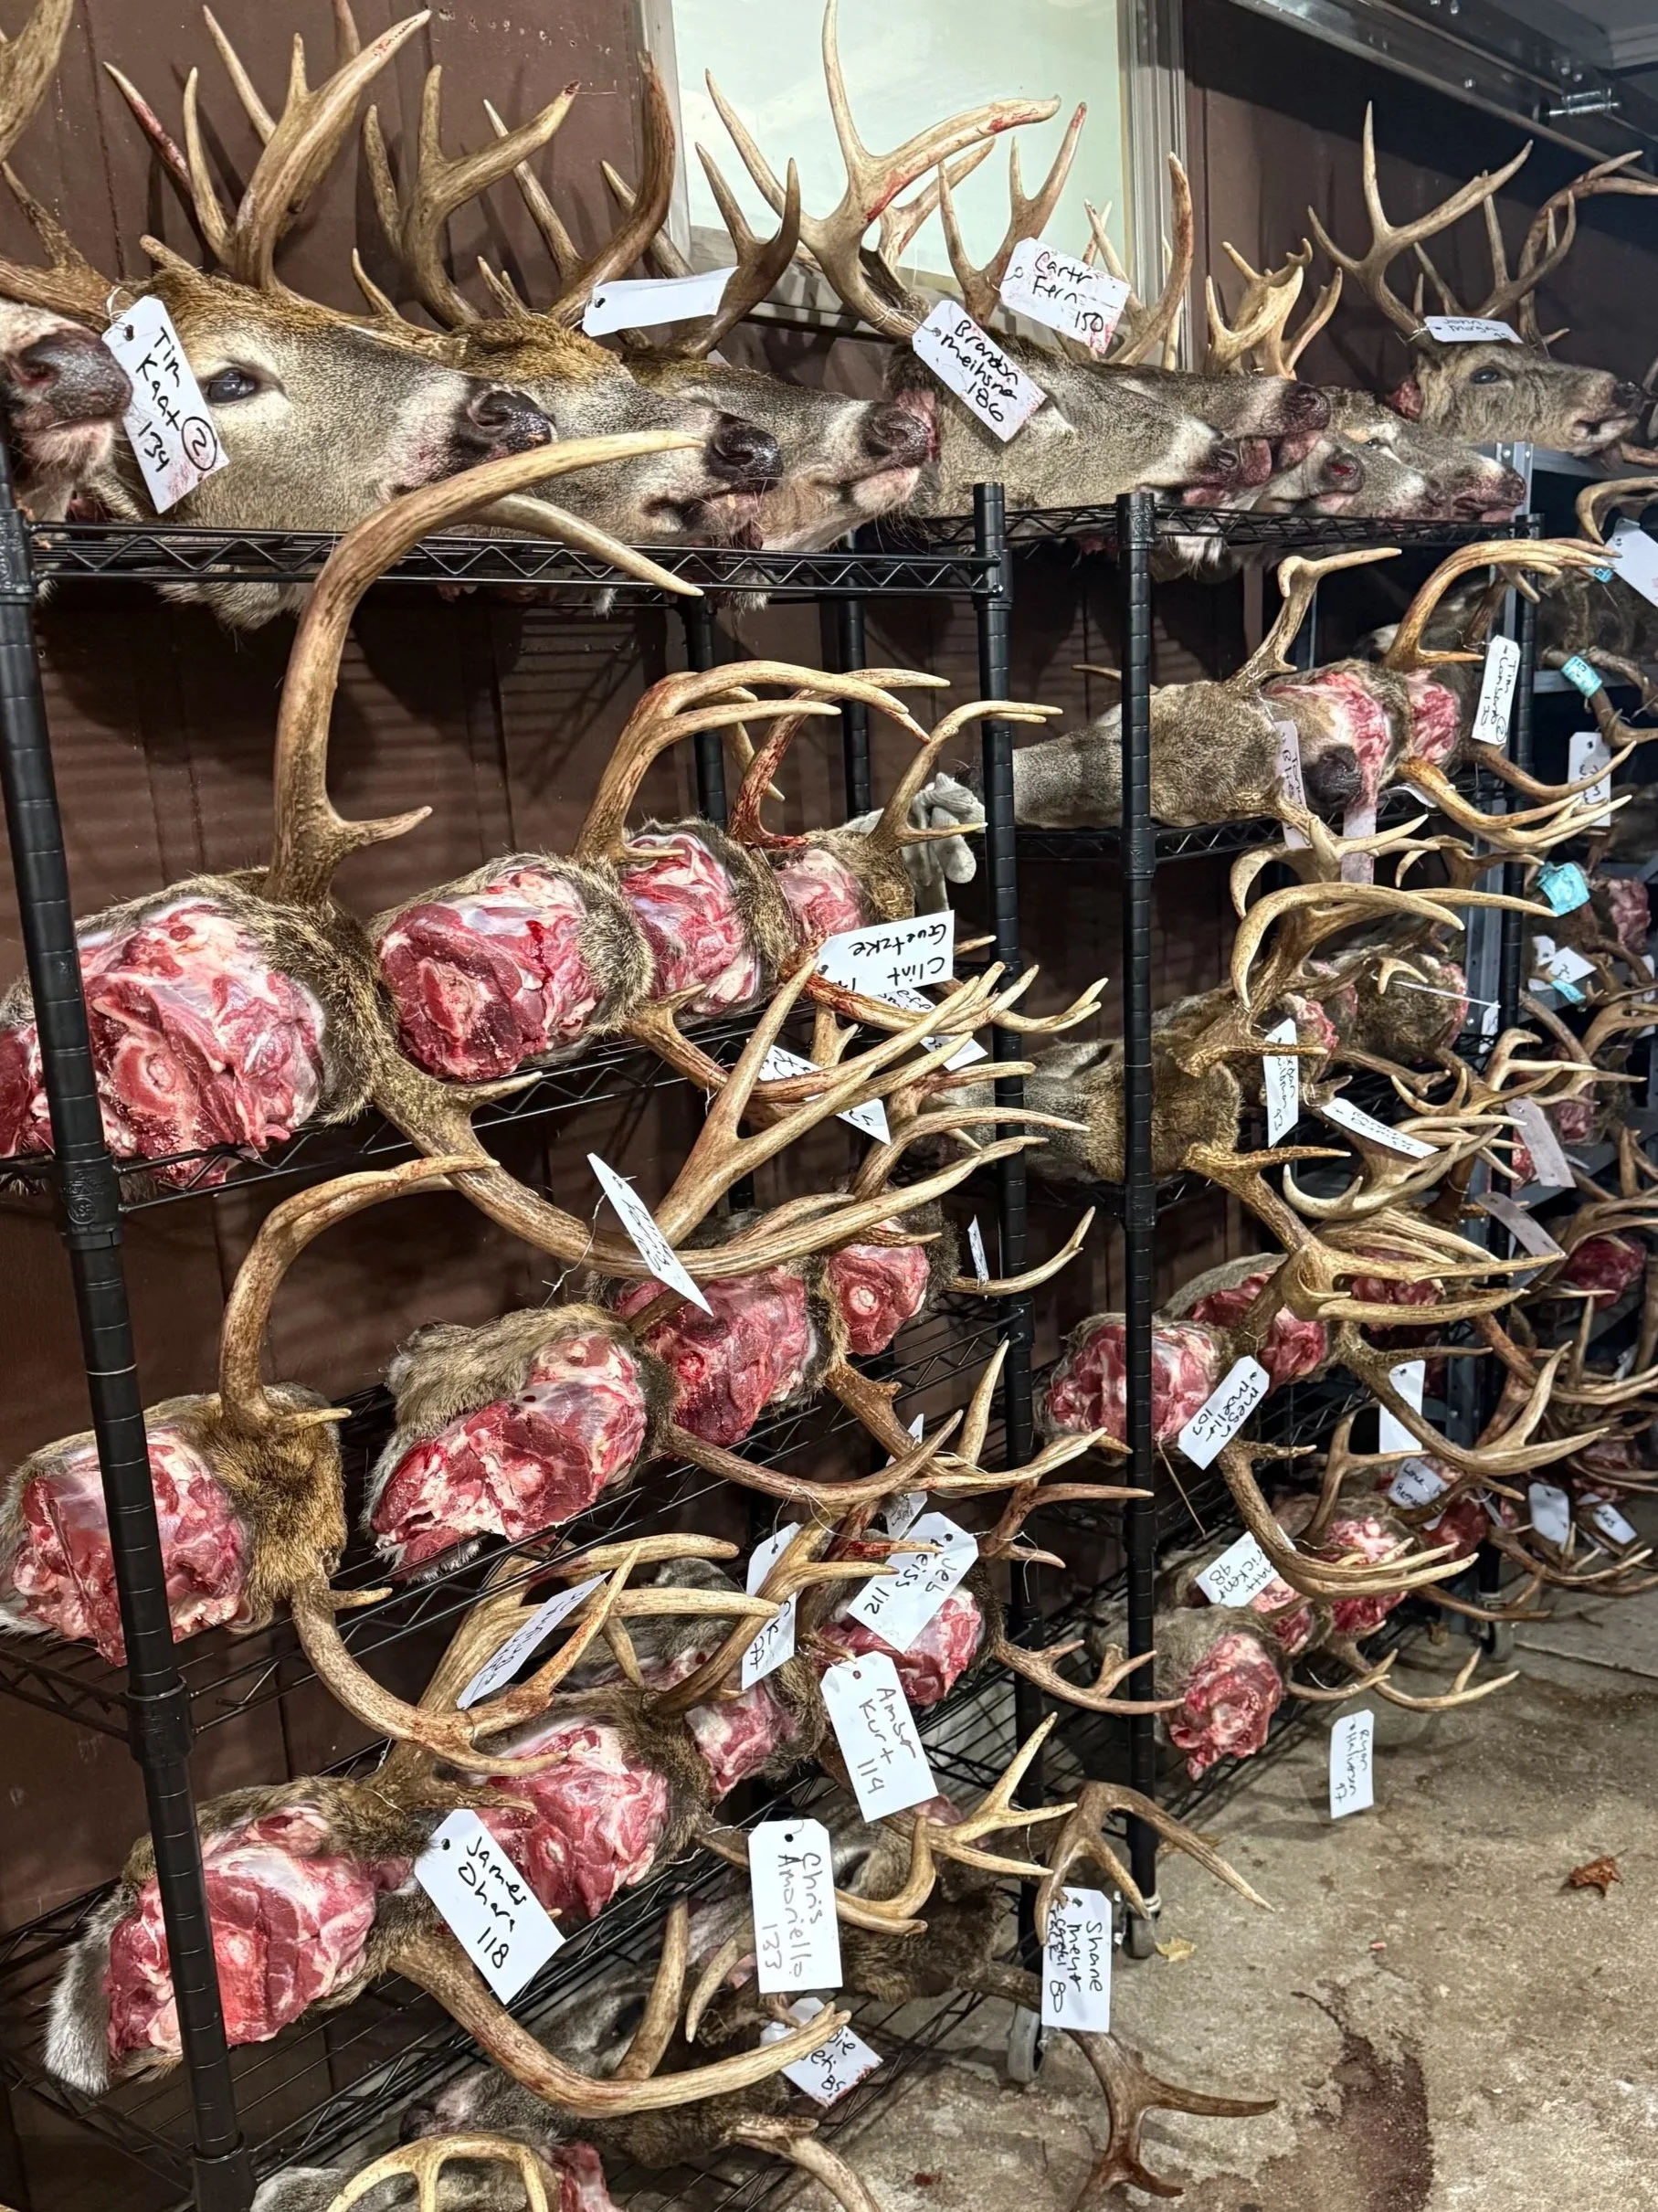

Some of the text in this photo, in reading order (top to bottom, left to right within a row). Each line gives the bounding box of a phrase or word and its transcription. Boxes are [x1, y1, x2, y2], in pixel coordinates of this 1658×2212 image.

[154, 326, 181, 387] Tim
[954, 320, 1019, 386] Brandon
[887, 957, 945, 986] Clint
[924, 1558, 957, 1593] Jeb
[859, 1699, 894, 1764] Kurt
[467, 1836, 527, 1905] James
[803, 1852, 823, 1925] Chris
[477, 1927, 509, 1969] 118
[1086, 1921, 1104, 1992] Shane
